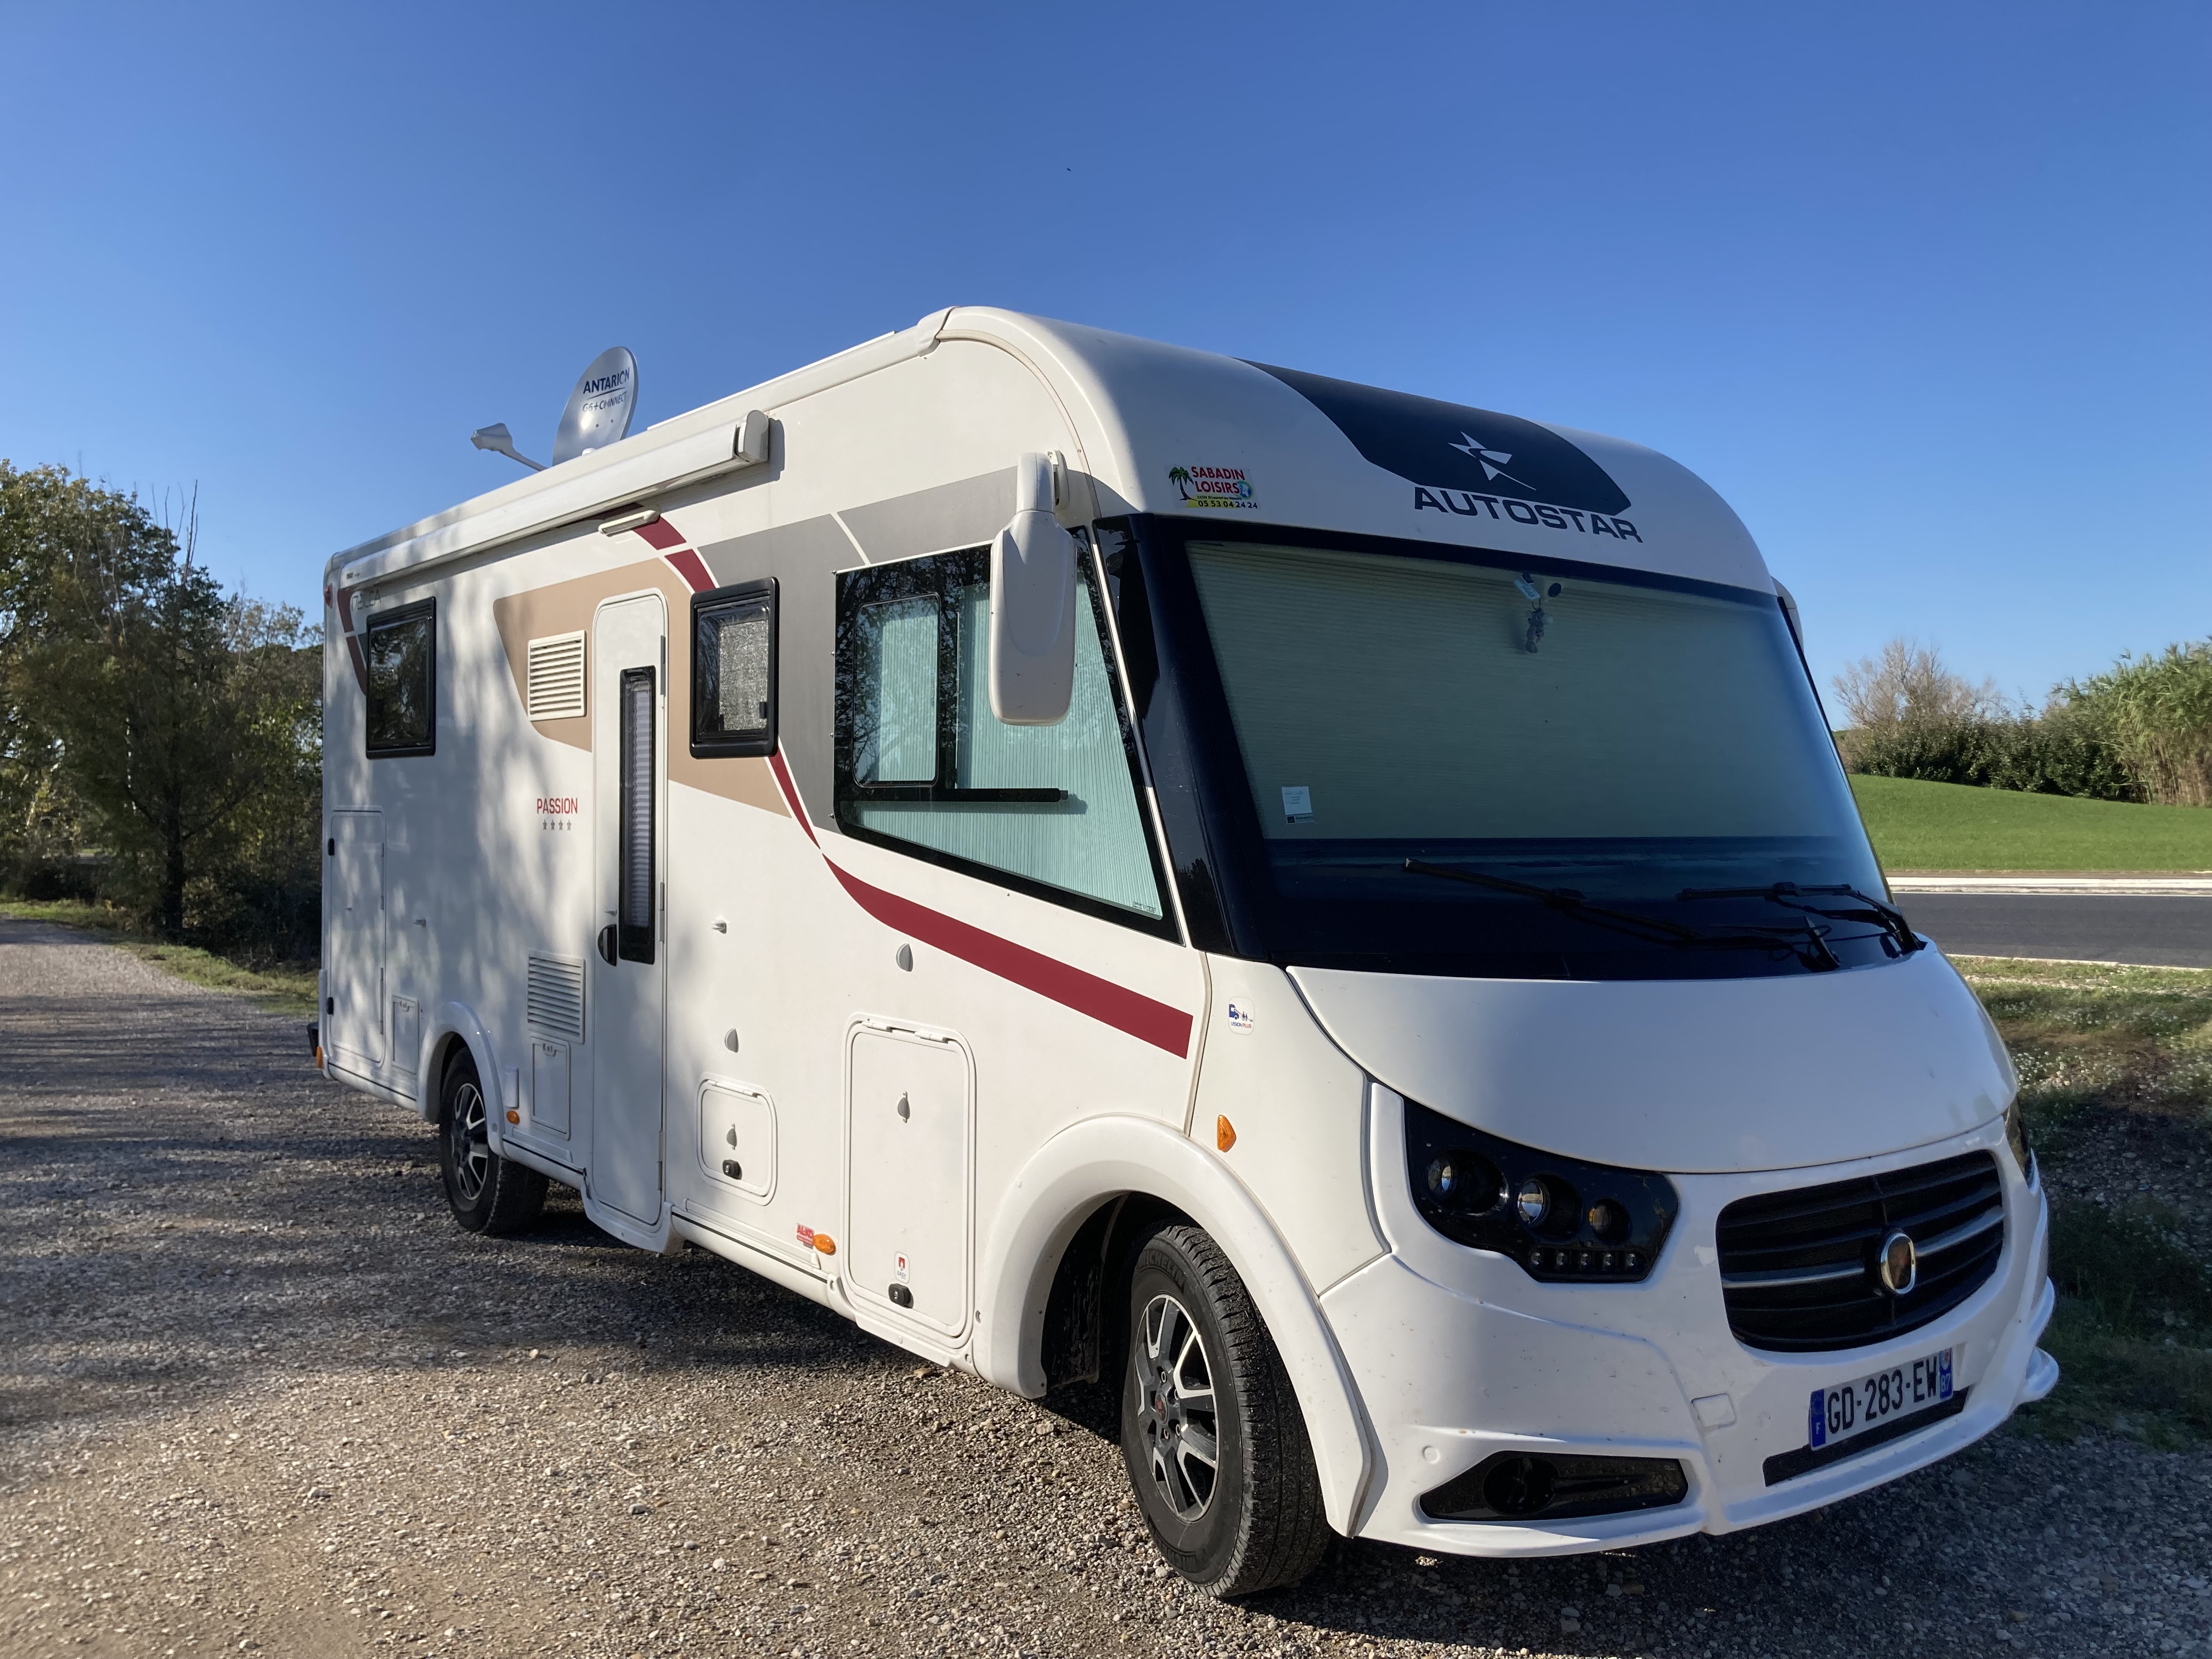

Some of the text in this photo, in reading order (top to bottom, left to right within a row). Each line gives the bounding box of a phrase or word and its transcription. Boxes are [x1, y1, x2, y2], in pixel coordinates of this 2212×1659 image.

[1191, 466, 1245, 481] SABADIN
[1194, 481, 1240, 494] LOISIRS
[1414, 486, 1644, 543] AUTOSTAR
[537, 798, 578, 814] PASSION
[1815, 1422, 1821, 1435] F
[1827, 1356, 1938, 1435] GD-283-EW
